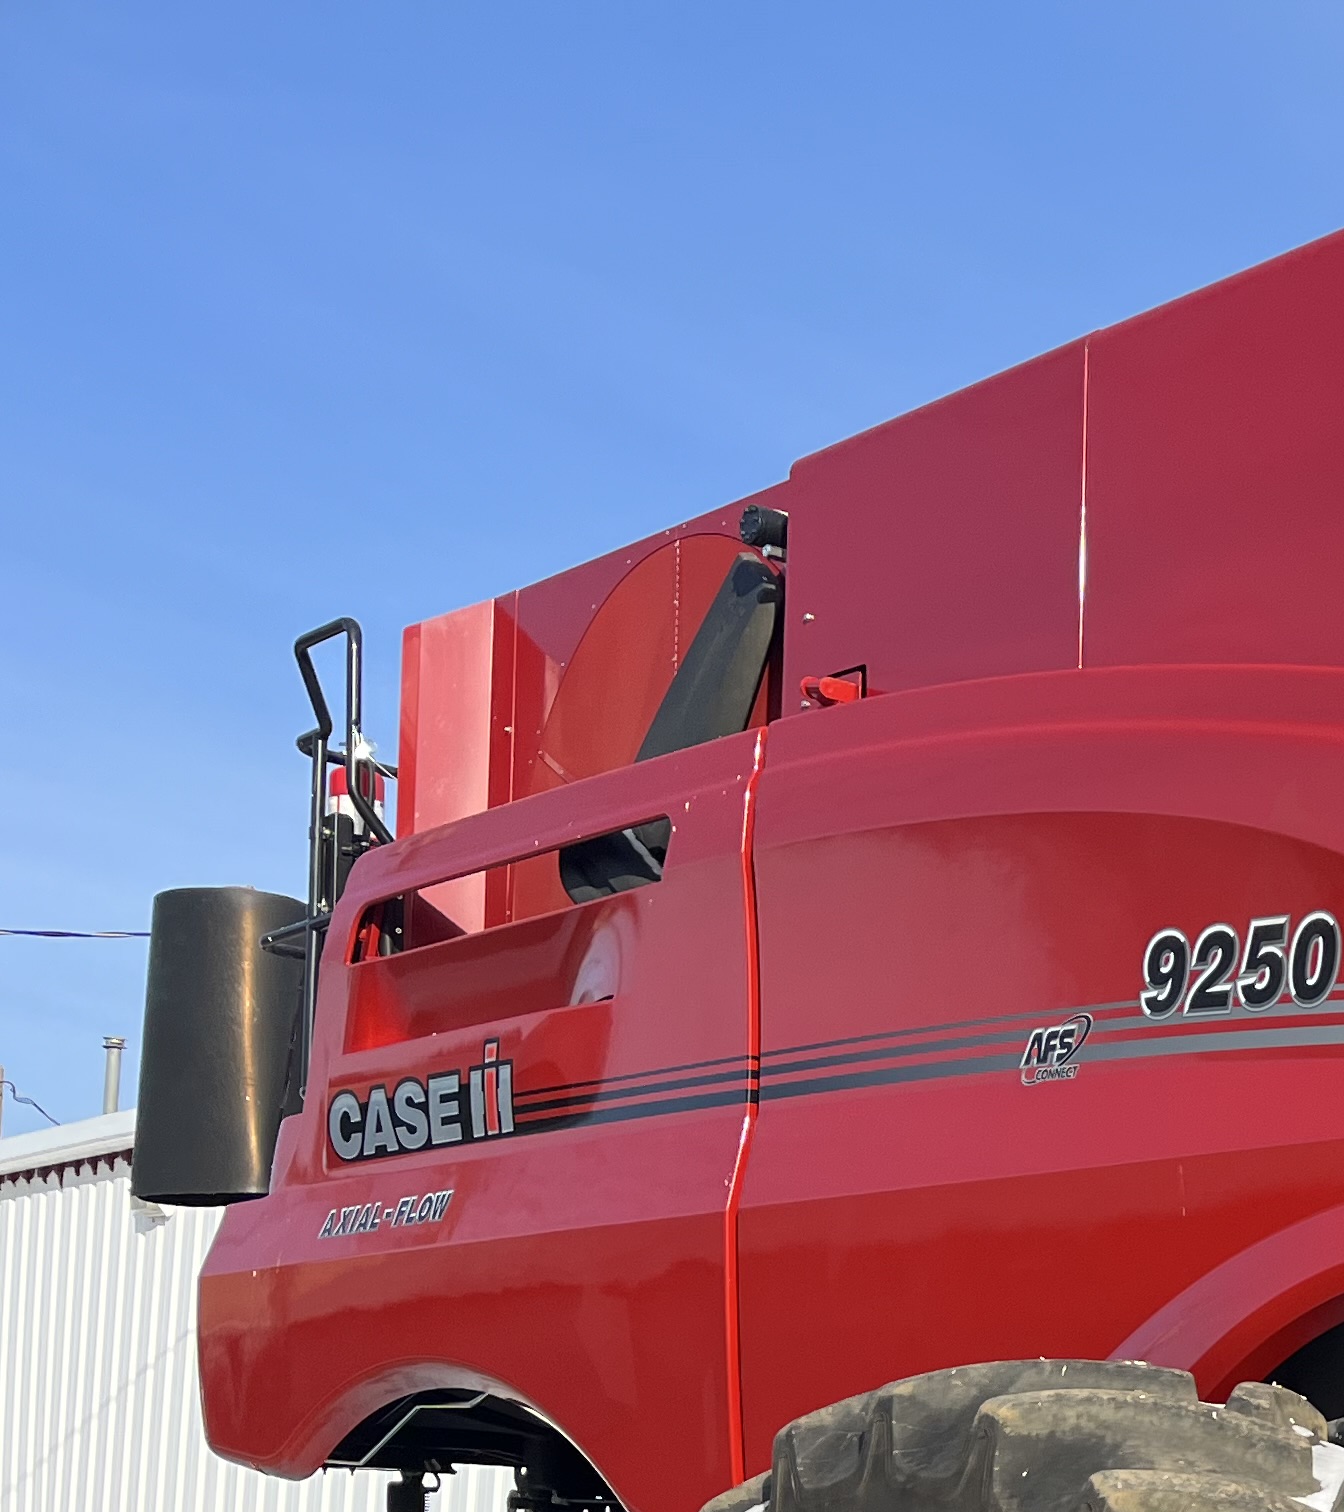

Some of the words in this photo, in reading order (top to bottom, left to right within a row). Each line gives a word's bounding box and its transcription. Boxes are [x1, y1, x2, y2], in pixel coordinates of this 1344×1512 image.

[1140, 909, 1341, 1021] 9250
[1019, 1024, 1079, 1068] AFS
[1035, 1064, 1080, 1081] CONNECT
[328, 1074, 463, 1160] CASE
[317, 1187, 455, 1239] AXIAL-FLOW
